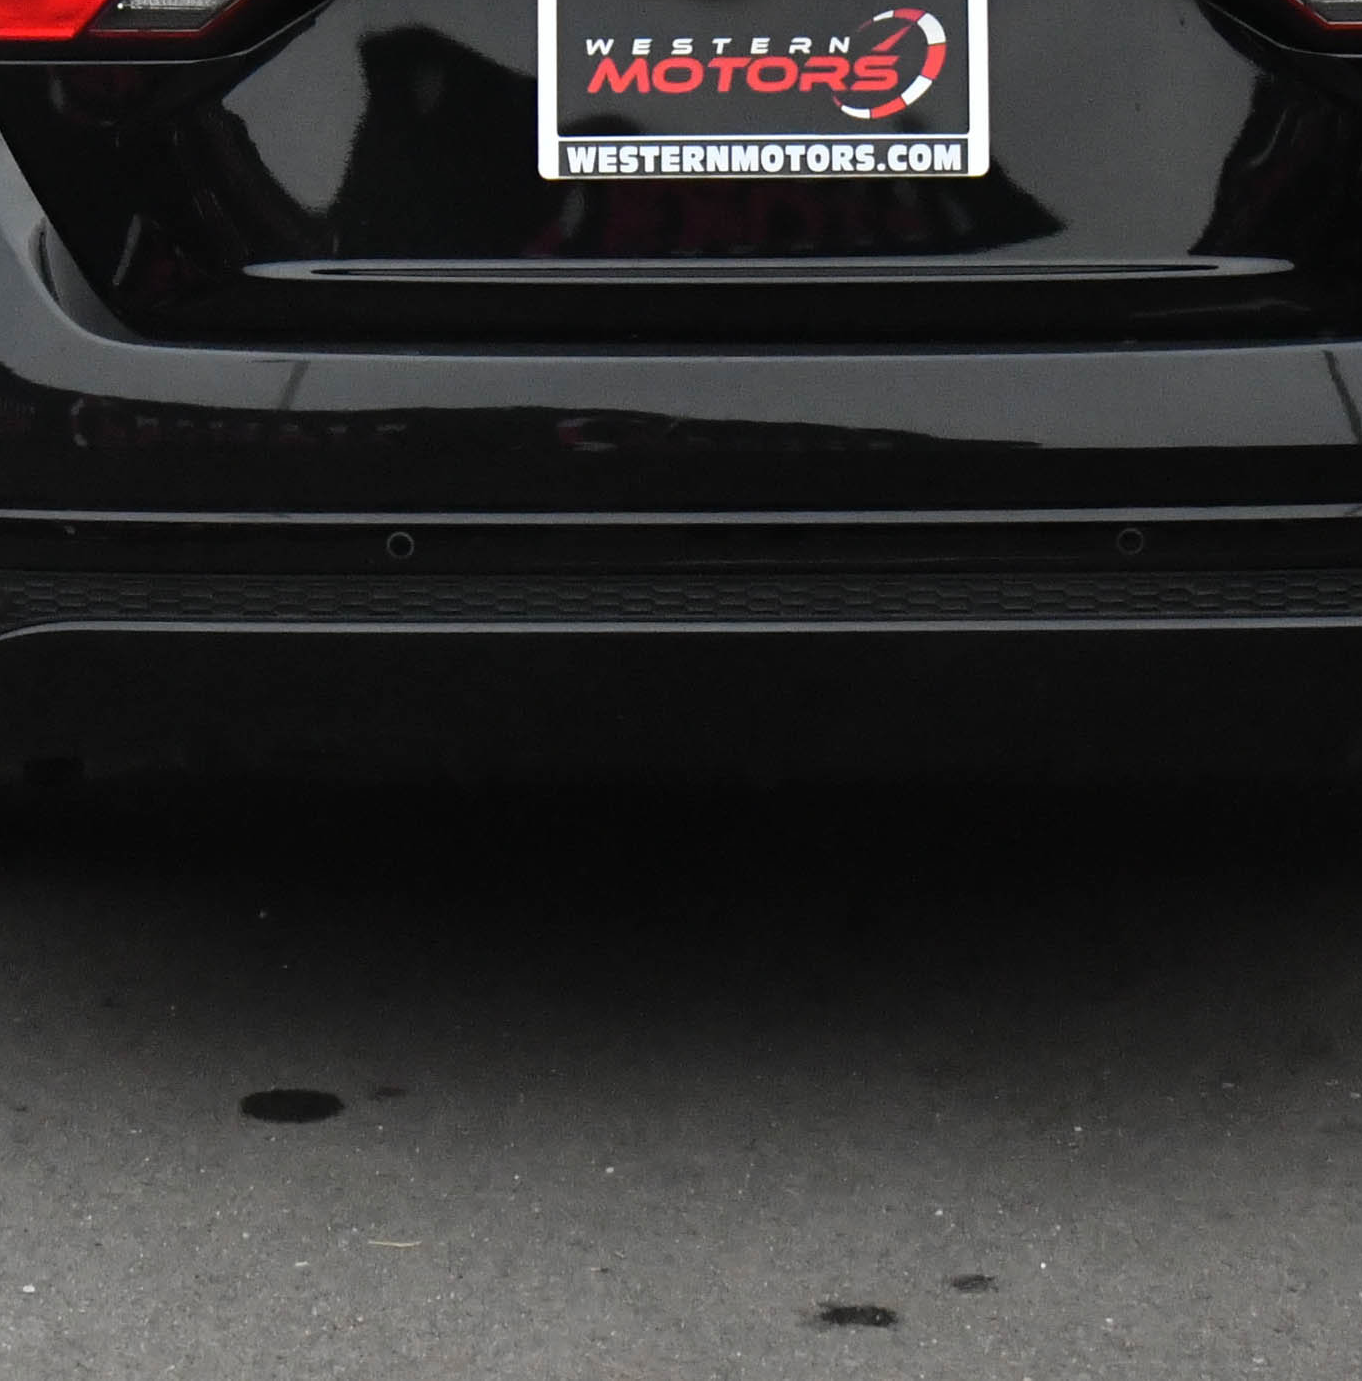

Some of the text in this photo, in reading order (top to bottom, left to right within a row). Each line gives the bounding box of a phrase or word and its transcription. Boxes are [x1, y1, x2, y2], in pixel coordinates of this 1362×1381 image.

[585, 37, 851, 55] WESTERN
[587, 56, 900, 94] MOTORS
[567, 143, 962, 174] WESTERNMOTORS.COM
